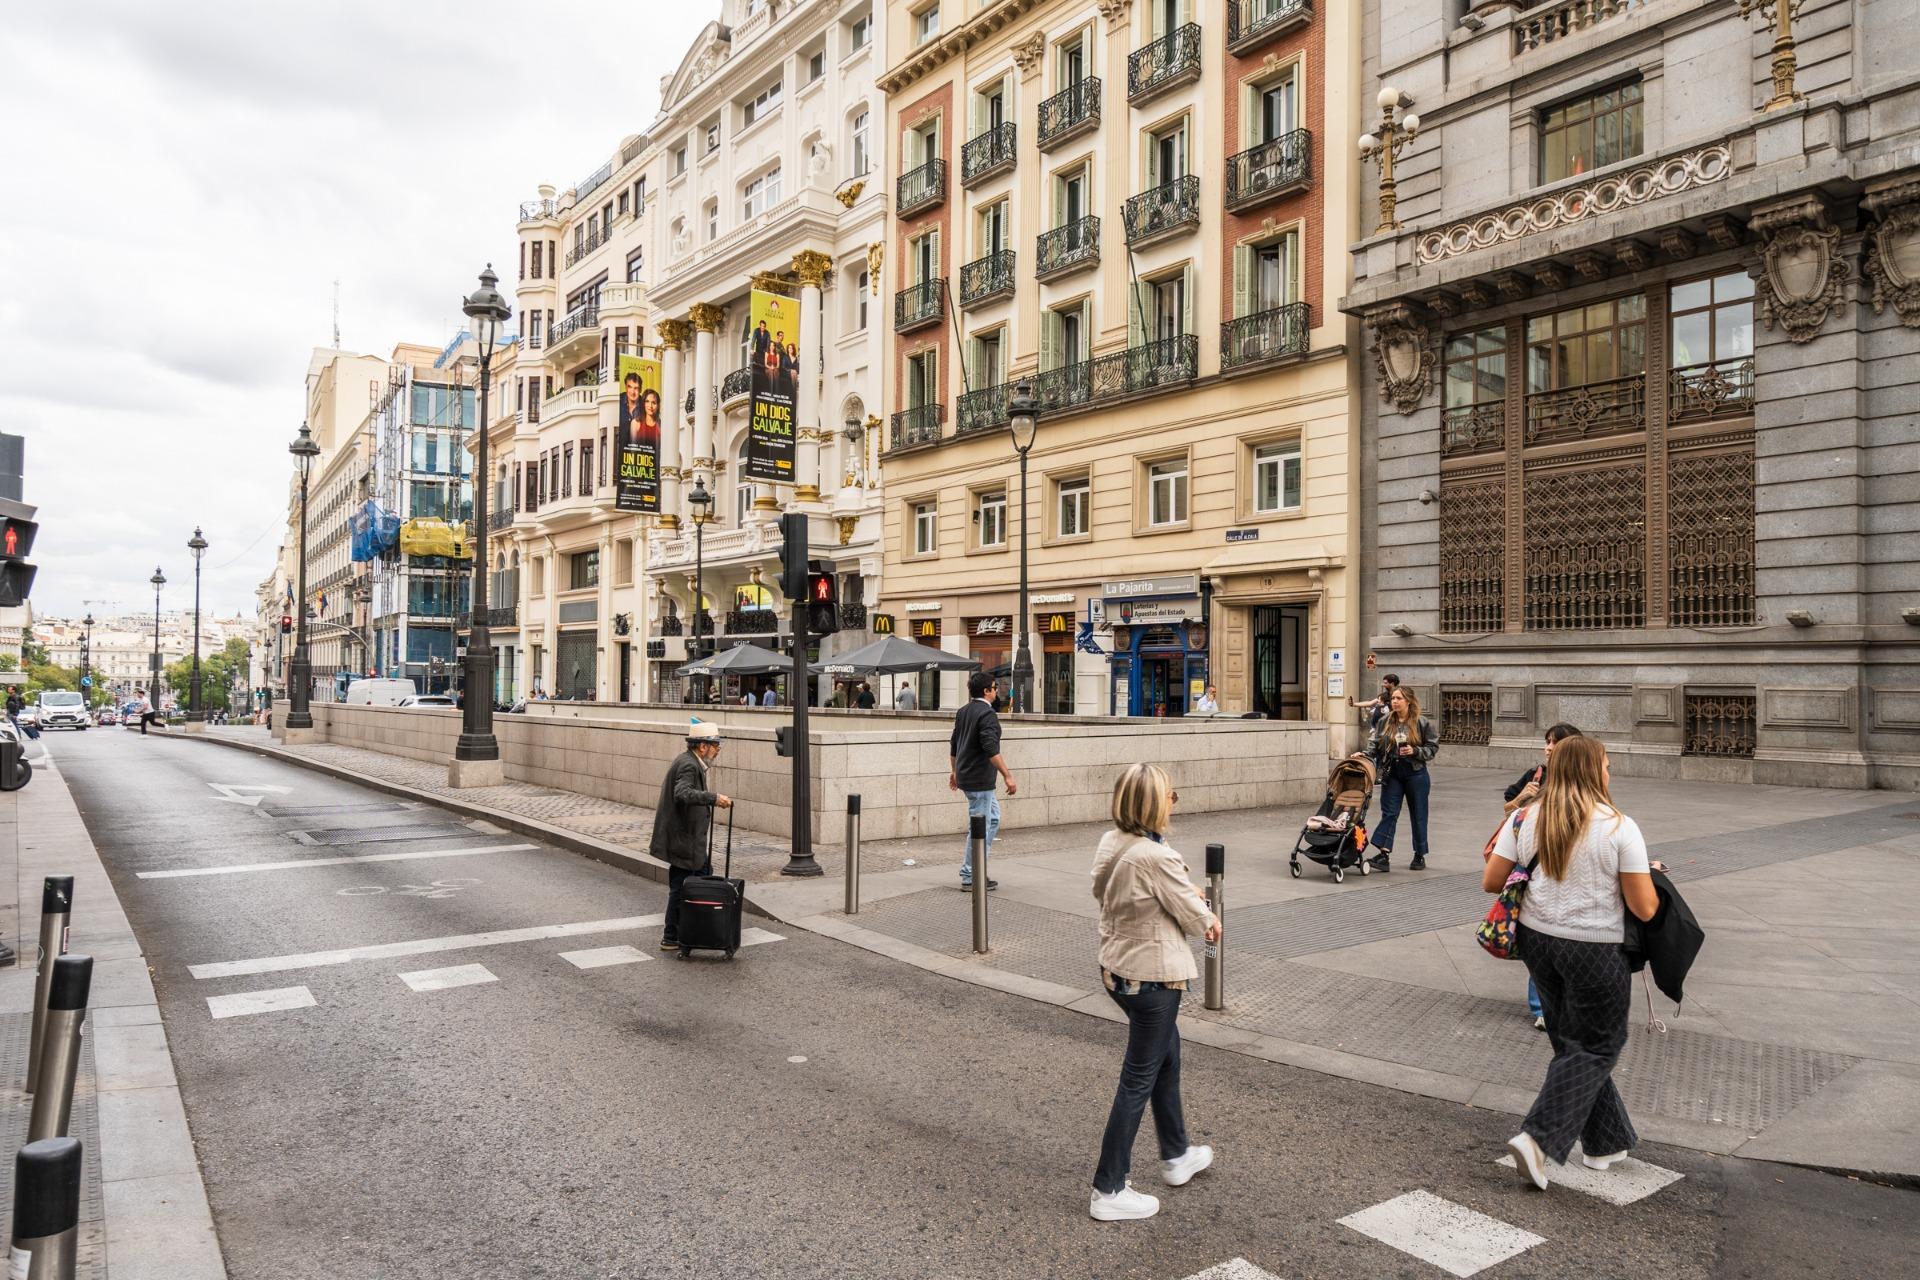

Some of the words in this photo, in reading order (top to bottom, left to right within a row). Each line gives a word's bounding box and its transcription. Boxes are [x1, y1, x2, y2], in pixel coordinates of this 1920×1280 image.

[756, 402, 767, 417] UN
[770, 405, 790, 421] DIOS
[753, 417, 792, 436] SALVAJE
[624, 452, 634, 465] UN
[637, 454, 654, 467] DIOS
[621, 465, 656, 479] SALVAJE
[1106, 583, 1117, 594] La
[1119, 581, 1153, 595] Pajarita
[824, 665, 855, 673] McDonald's
